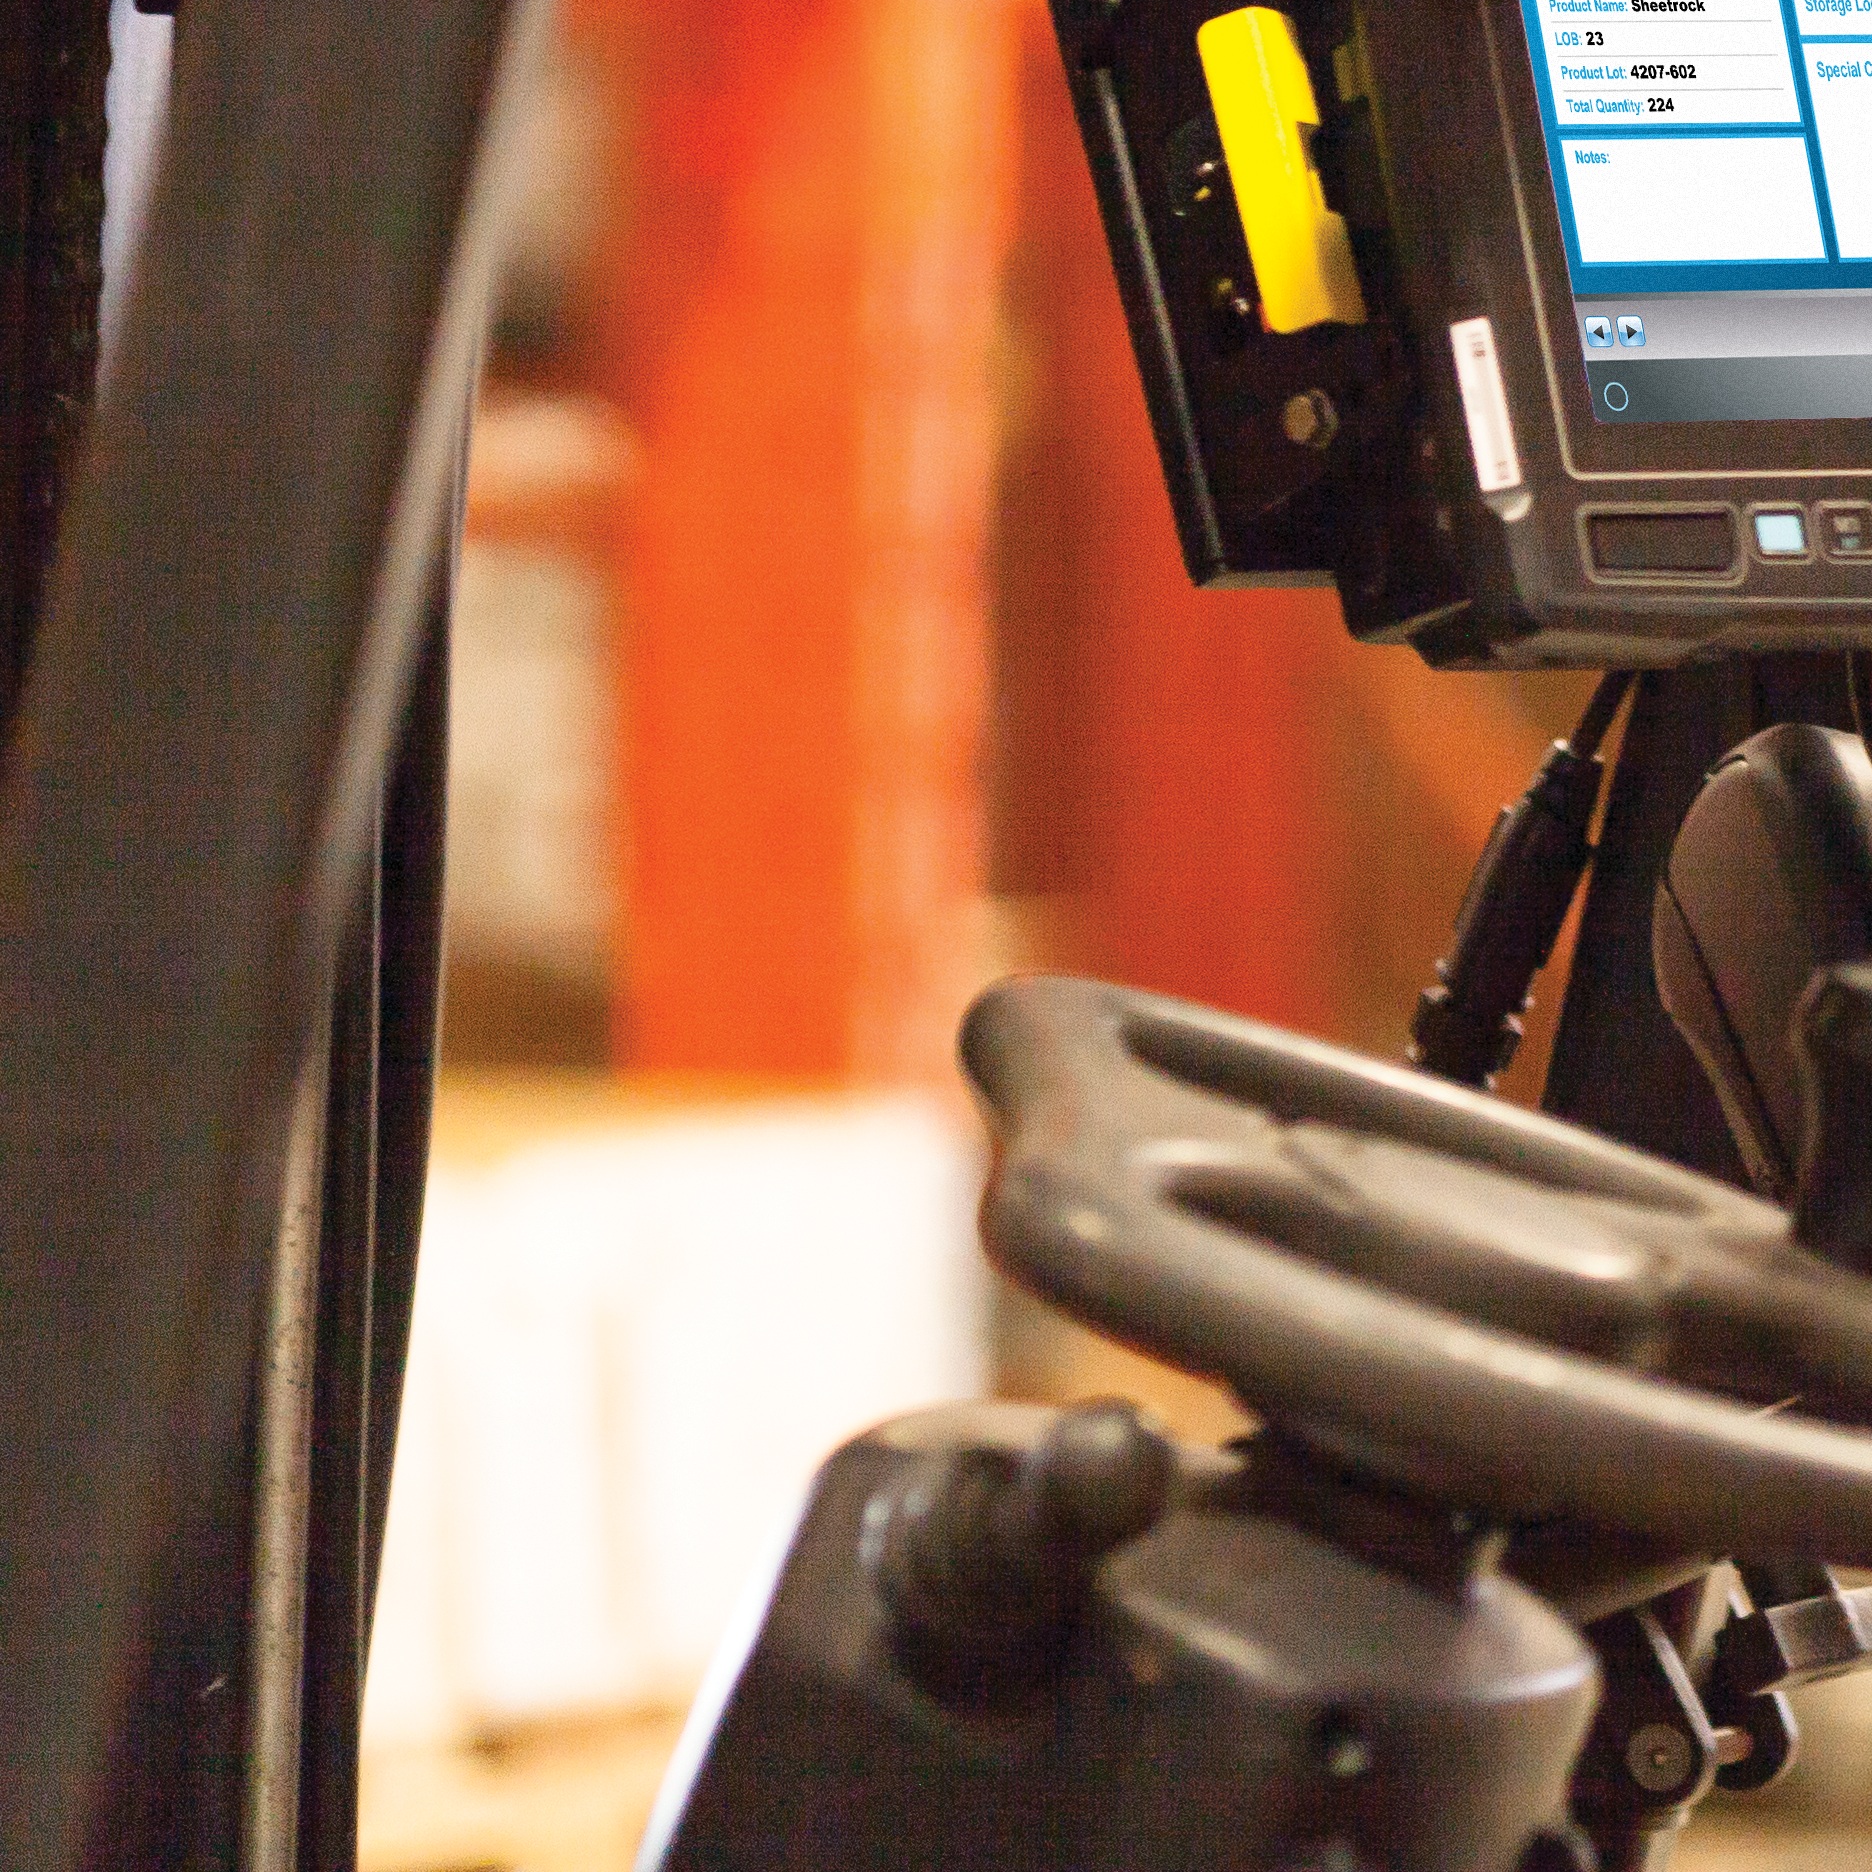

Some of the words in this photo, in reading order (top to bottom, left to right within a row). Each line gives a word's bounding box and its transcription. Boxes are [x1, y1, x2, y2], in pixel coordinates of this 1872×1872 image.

[1554, 32, 1583, 46] LOB:
[1585, 32, 1604, 46] 23
[1561, 65, 1603, 80] Product
[1605, 65, 1628, 80] Lot:
[1630, 65, 1697, 79] 4207-602
[1816, 61, 1861, 81] Special
[1566, 99, 1594, 113] Total
[1596, 99, 1645, 115] Quantity:
[1647, 98, 1675, 112] 224
[1574, 150, 1611, 164] Notes:
